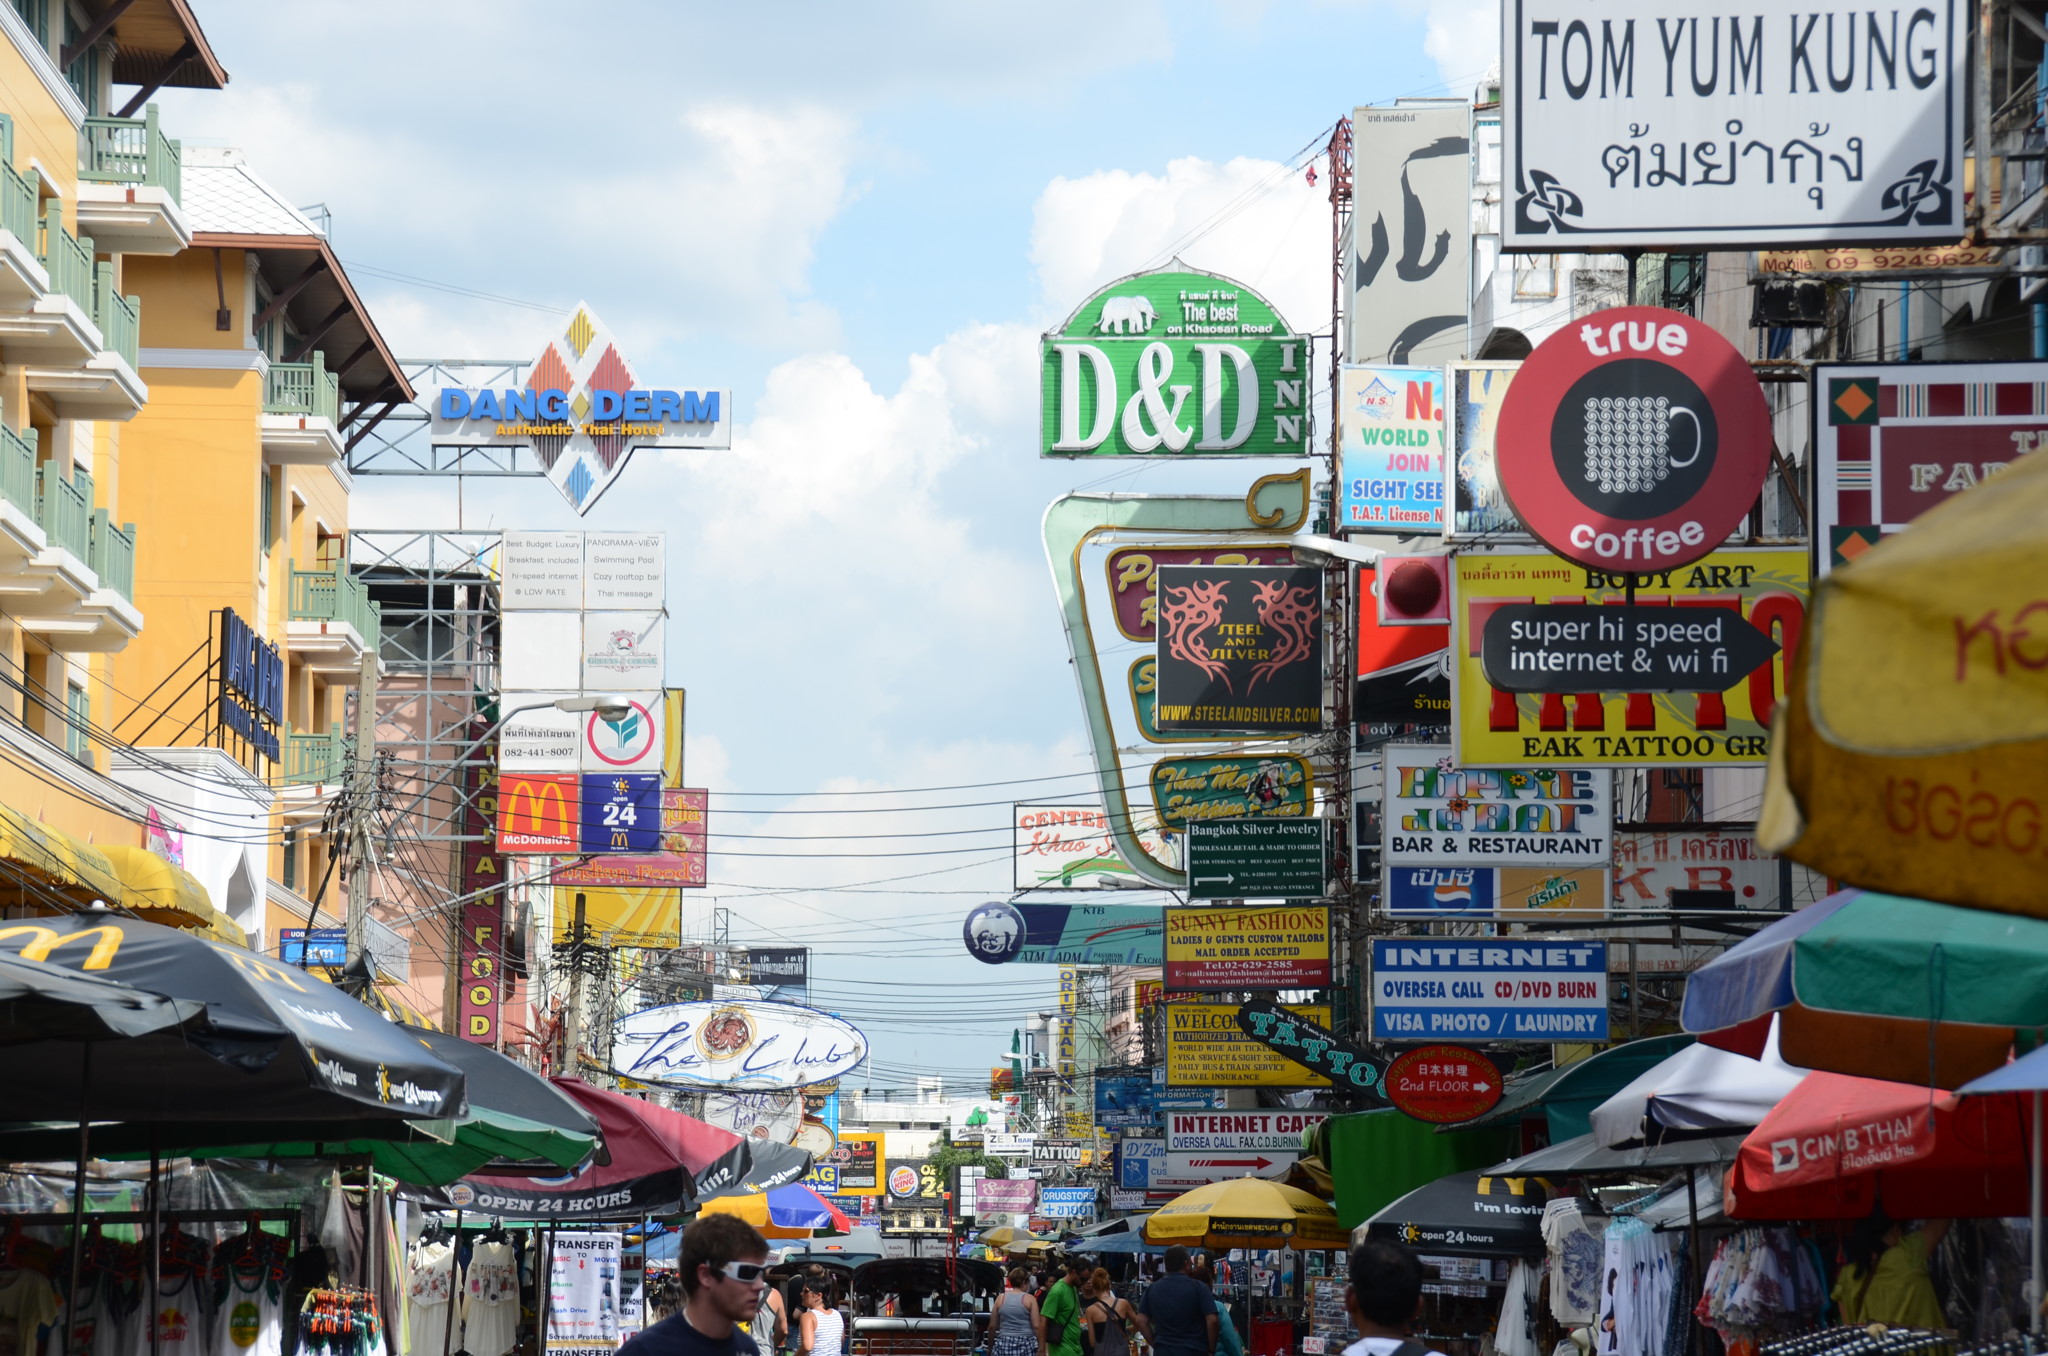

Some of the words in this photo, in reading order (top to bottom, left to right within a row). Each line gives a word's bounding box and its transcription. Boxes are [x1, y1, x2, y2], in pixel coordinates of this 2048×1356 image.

[1532, 17, 1636, 100] TOM
[1657, 16, 1764, 97] YUM
[1789, 7, 1937, 94] KUNG
[1601, 119, 1864, 210] ต้มยำกุ้ง
[1183, 302, 1207, 321] The
[1210, 302, 1239, 321] best
[1167, 325, 1182, 334] on
[1185, 323, 1238, 334] Khaosan
[1241, 323, 1273, 334] Road
[1580, 321, 1688, 356] true
[1052, 341, 1259, 453] D&D
[1273, 343, 1302, 444] INN
[440, 387, 569, 421] DANG
[592, 389, 720, 422] DERM
[495, 421, 573, 437] Authentic
[581, 421, 614, 436] Thai
[621, 422, 665, 436] Hotel
[1362, 427, 1430, 447] WORLD
[1386, 453, 1430, 472] JOIN
[1352, 479, 1408, 499] SIGHT
[1351, 505, 1385, 521] T.A.T.
[1389, 507, 1430, 522] License
[506, 540, 523, 548] Best
[526, 540, 552, 549] Budget
[555, 540, 580, 549] Luxury
[587, 539, 660, 547] PANORAMA-VIEW
[509, 556, 545, 564] Breakfast
[547, 556, 579, 564] included
[594, 556, 635, 565] Swimming
[637, 556, 655, 564] Pool
[511, 572, 546, 581] hi-speed
[548, 572, 579, 580] internet
[593, 573, 612, 581] Cozy
[615, 573, 645, 581] rooftop
[647, 573, 660, 581] bar
[1688, 565, 1755, 588] ART
[617, 591, 653, 599] message
[1217, 624, 1265, 636] STEEL
[1510, 620, 1592, 646] super
[1598, 615, 1624, 641] hi
[1636, 617, 1722, 647] speed
[1223, 638, 1256, 646] AND
[1209, 648, 1270, 660] SILVER
[1510, 645, 1624, 672] internet
[1631, 651, 1653, 673] &
[1667, 649, 1699, 673] wi
[1711, 648, 1728, 673] fi
[1160, 704, 1320, 723] WWW.STEELANDSILVER.COM
[1359, 723, 1397, 738] Body
[504, 748, 574, 757] 082-441-8007
[1522, 737, 1585, 757] EAK
[1593, 736, 1715, 757] TATTOO
[1157, 766, 1208, 794] Thai
[602, 802, 637, 826] 24
[474, 738, 498, 907] INDIAN
[1191, 824, 1240, 838] Bangkok
[1242, 823, 1275, 836] Silver
[1276, 823, 1320, 837] Jewelry
[503, 834, 571, 845] McDonald's
[1020, 830, 1091, 856] Khao
[1392, 837, 1433, 852] BAR
[1442, 837, 1458, 852] &
[1469, 838, 1603, 854] RESTAURANT
[561, 863, 629, 883] Indian
[636, 861, 690, 880] Food
[1083, 906, 1106, 915] KTB
[1170, 914, 1230, 932] SUNNY
[1237, 912, 1324, 931] FASHIONS
[1171, 935, 1203, 945] LADIES
[1216, 934, 1245, 944] GENTS
[1248, 934, 1284, 943] CUSTOM
[1286, 933, 1325, 943] TAILORS
[1020, 951, 1045, 962] ATM
[1055, 951, 1082, 963] ADM
[1093, 951, 1124, 959] PASSBOOK
[1195, 948, 1217, 957] MAIL
[1220, 947, 1250, 957] ORDER
[1254, 946, 1300, 956] ACCEPTED
[1385, 948, 1593, 967] INTERNET
[1202, 960, 1293, 970] Tel.02-629-2585
[469, 926, 493, 1037] FOOD
[1198, 977, 1299, 986] www.sunnyfashions.com
[1383, 980, 1447, 999] OVERSEA
[1451, 981, 1484, 999] CALL
[1494, 980, 1552, 1001] CD/DVD
[1557, 982, 1597, 999] BURN
[1060, 971, 1074, 1057] ORIENTAL
[1269, 1006, 1285, 1018] See
[1286, 1014, 1300, 1027] the
[1302, 1022, 1338, 1047] Amazing
[1384, 1013, 1425, 1031] VISA
[1431, 1013, 1491, 1032] PHOTO
[1515, 1014, 1598, 1033] LAUNDRY
[1175, 1032, 1228, 1041] AUTHORIZED
[625, 1021, 705, 1074] The
[742, 1034, 852, 1073] Club
[1206, 1044, 1224, 1052] WIDE
[1177, 1063, 1200, 1071] DAILY
[1253, 1063, 1286, 1071] SERVICE
[1387, 1048, 1437, 1086] Japanese
[1440, 1045, 1500, 1088] Restaurant
[1418, 1063, 1469, 1077] 日本料理
[1400, 1077, 1424, 1092] 2nd
[1429, 1078, 1470, 1092] FLOOR
[1173, 1115, 1271, 1134] INTERNET
[1172, 1136, 1211, 1149] OVERSEA
[1213, 1136, 1237, 1149] CALL,
[1802, 1128, 1860, 1160] CIMB
[1866, 1116, 1912, 1145] THAI
[1033, 1146, 1081, 1160] TATTOO
[477, 1193, 533, 1212] OPEN
[539, 1200, 563, 1212] 24
[568, 1189, 632, 1211] HOURS
[1043, 1190, 1095, 1200] DRUGSTORE
[1057, 1204, 1094, 1216] ขายยา
[1473, 1201, 1500, 1213] i'm
[1421, 1230, 1445, 1240] open
[1445, 1229, 1465, 1244] 24
[1466, 1233, 1494, 1243] hours
[553, 1240, 614, 1250] TRANSFER
